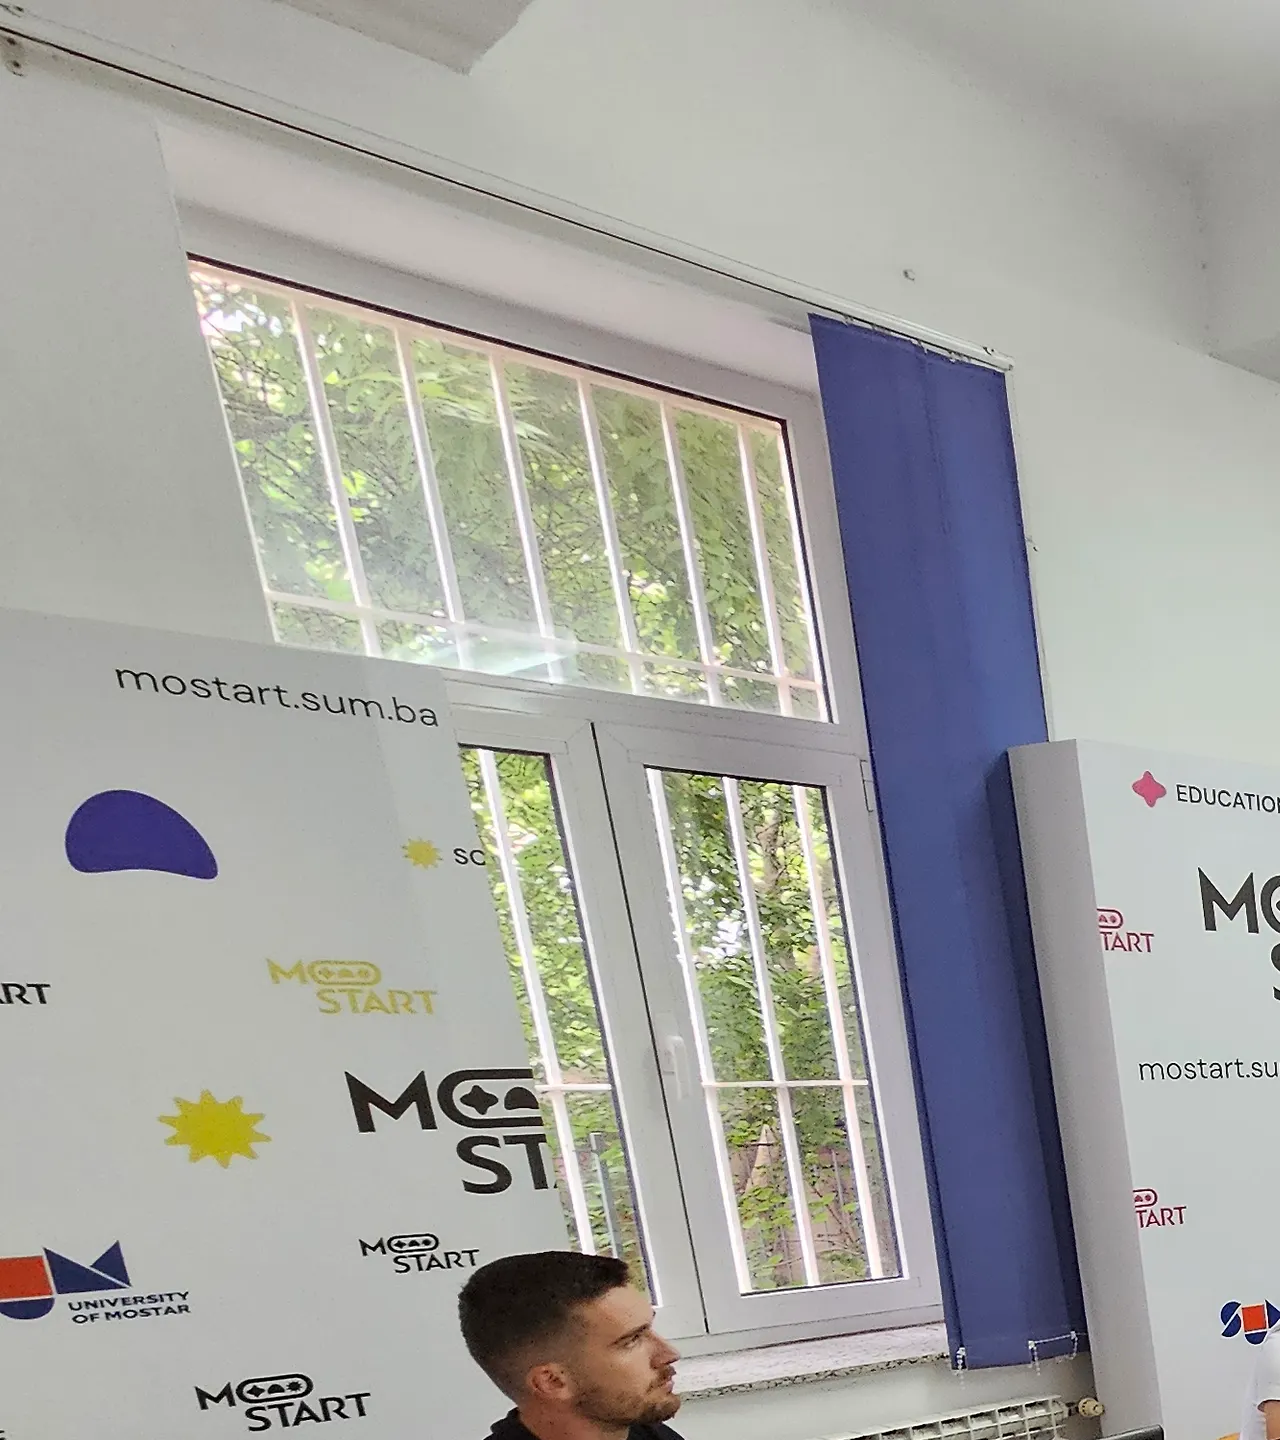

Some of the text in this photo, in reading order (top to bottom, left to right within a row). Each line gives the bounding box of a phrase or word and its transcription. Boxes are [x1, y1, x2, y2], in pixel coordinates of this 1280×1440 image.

[115, 666, 439, 728] mostart.sum.ba
[1099, 931, 1154, 953] TART
[317, 988, 438, 1015] START
[1136, 1206, 1187, 1229] TART
[393, 1248, 480, 1274] START
[68, 1291, 189, 1312] UNIVERSITY
[72, 1305, 191, 1325] OF MOSTAR
[247, 1392, 372, 1431] START
